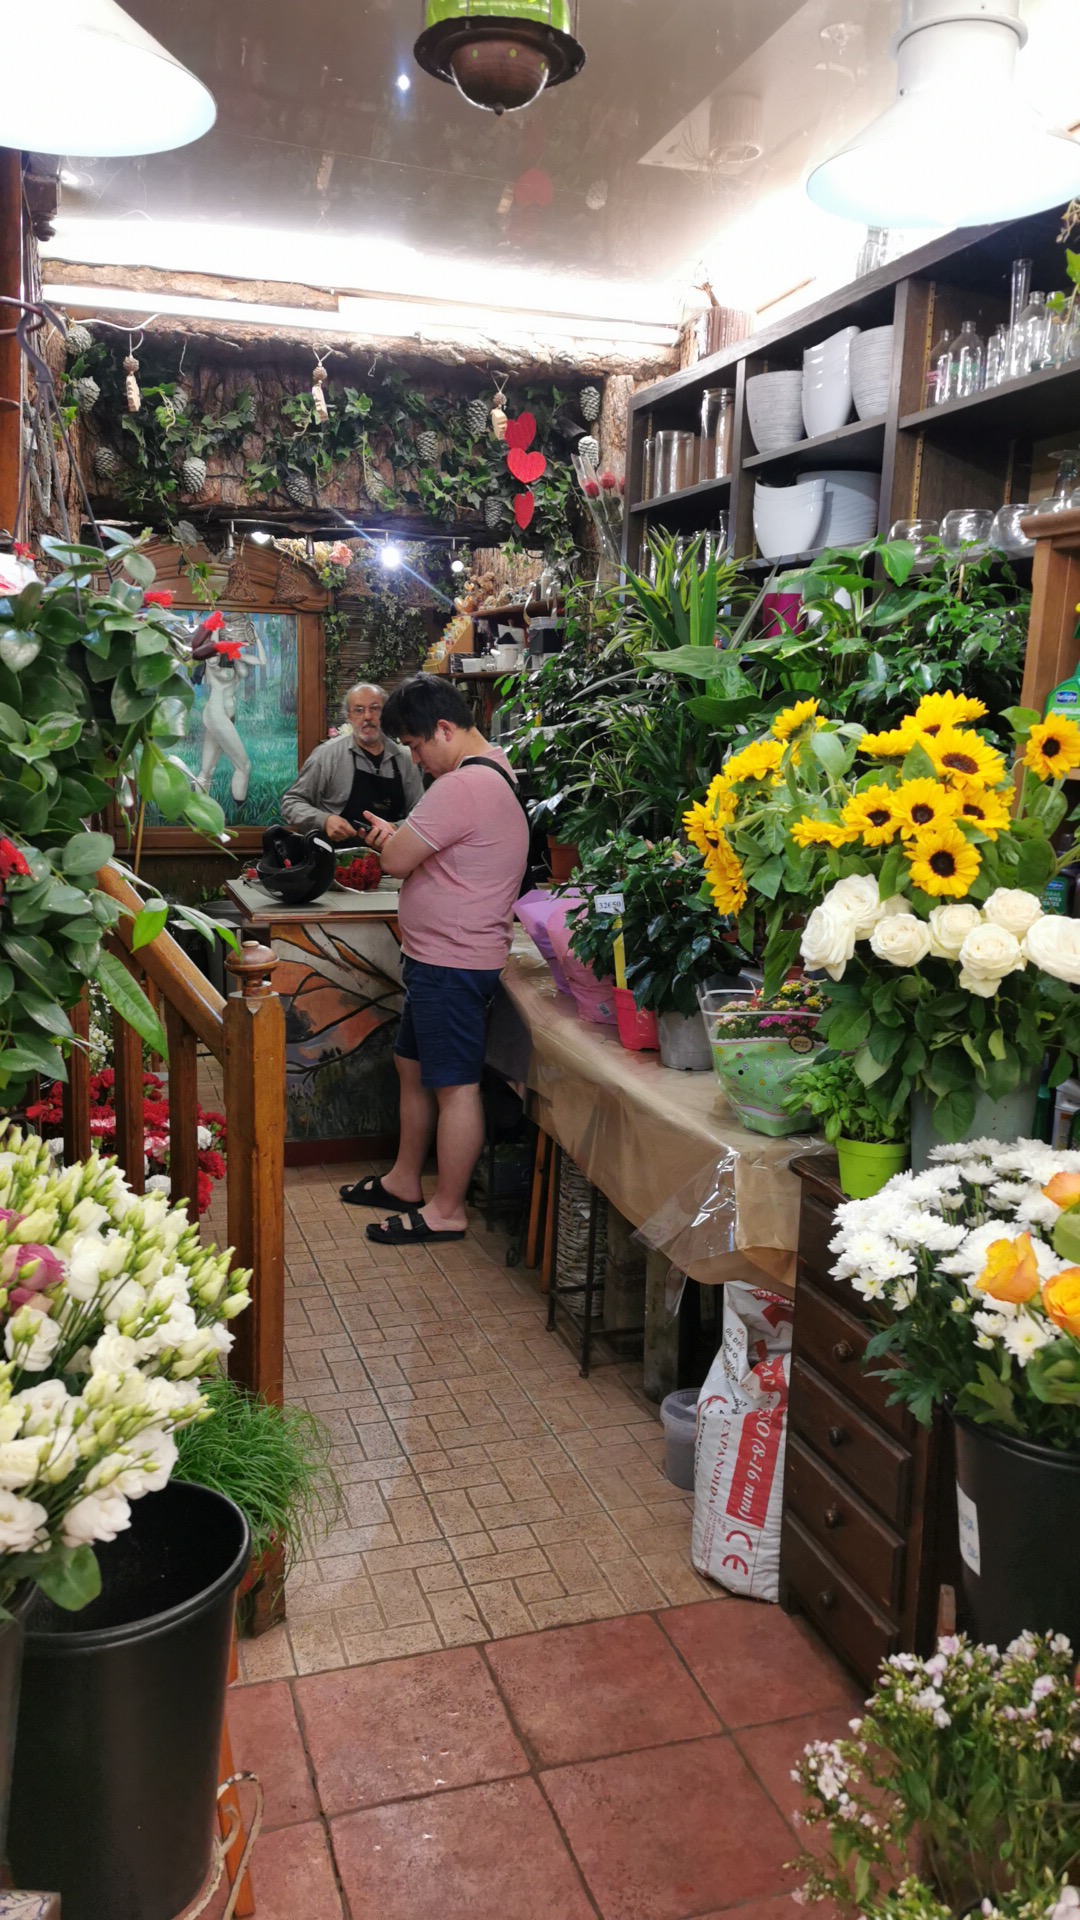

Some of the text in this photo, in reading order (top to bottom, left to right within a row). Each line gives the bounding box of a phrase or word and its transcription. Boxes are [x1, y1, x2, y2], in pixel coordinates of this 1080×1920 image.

[709, 1419, 732, 1504] EXPANDIDA
[737, 1483, 756, 1520] mm)
[722, 1530, 753, 1576] CE
